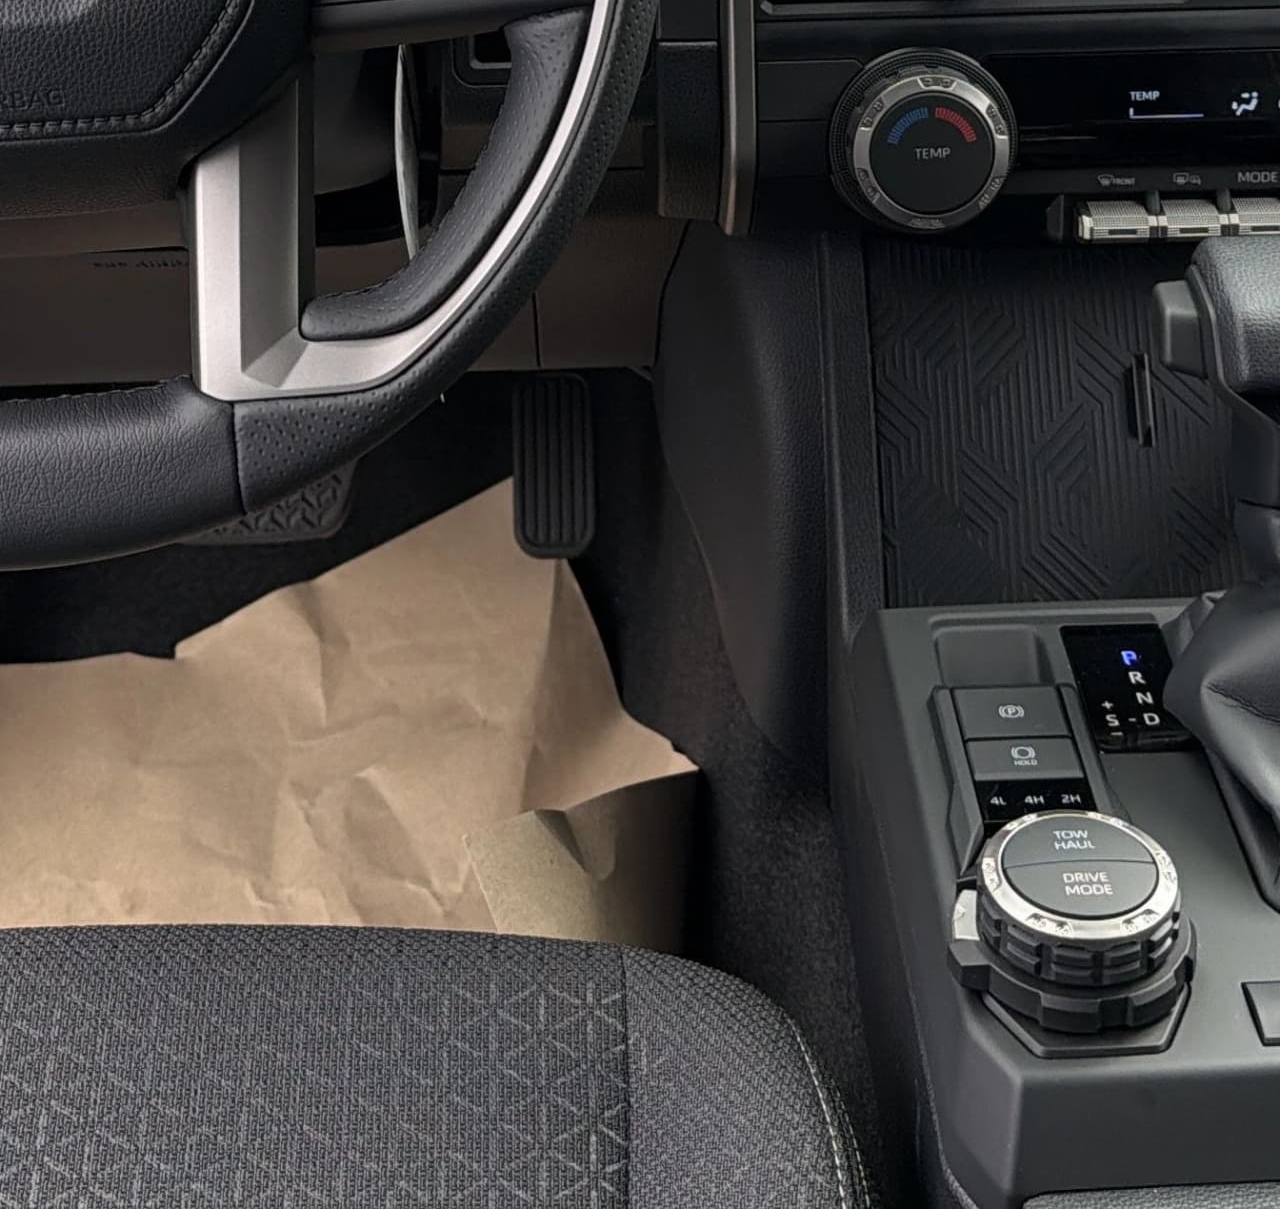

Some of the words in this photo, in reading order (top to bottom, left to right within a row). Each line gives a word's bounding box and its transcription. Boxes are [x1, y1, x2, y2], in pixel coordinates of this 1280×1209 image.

[1128, 90, 1160, 101] TEMP
[915, 147, 951, 160] TEMP
[1237, 171, 1279, 184] MODE
[1121, 651, 1137, 666] P
[1128, 671, 1146, 684] R
[1136, 691, 1154, 705] N
[1105, 714, 1120, 727] S
[1143, 712, 1160, 726] D
[990, 796, 1007, 806] 4L
[1024, 795, 1045, 805] 4H
[1060, 793, 1081, 804] 2H
[1053, 830, 1088, 839] TOW
[1054, 840, 1096, 850] HAUL
[1062, 871, 1109, 883] DRIVE
[1065, 884, 1114, 896] MODE
